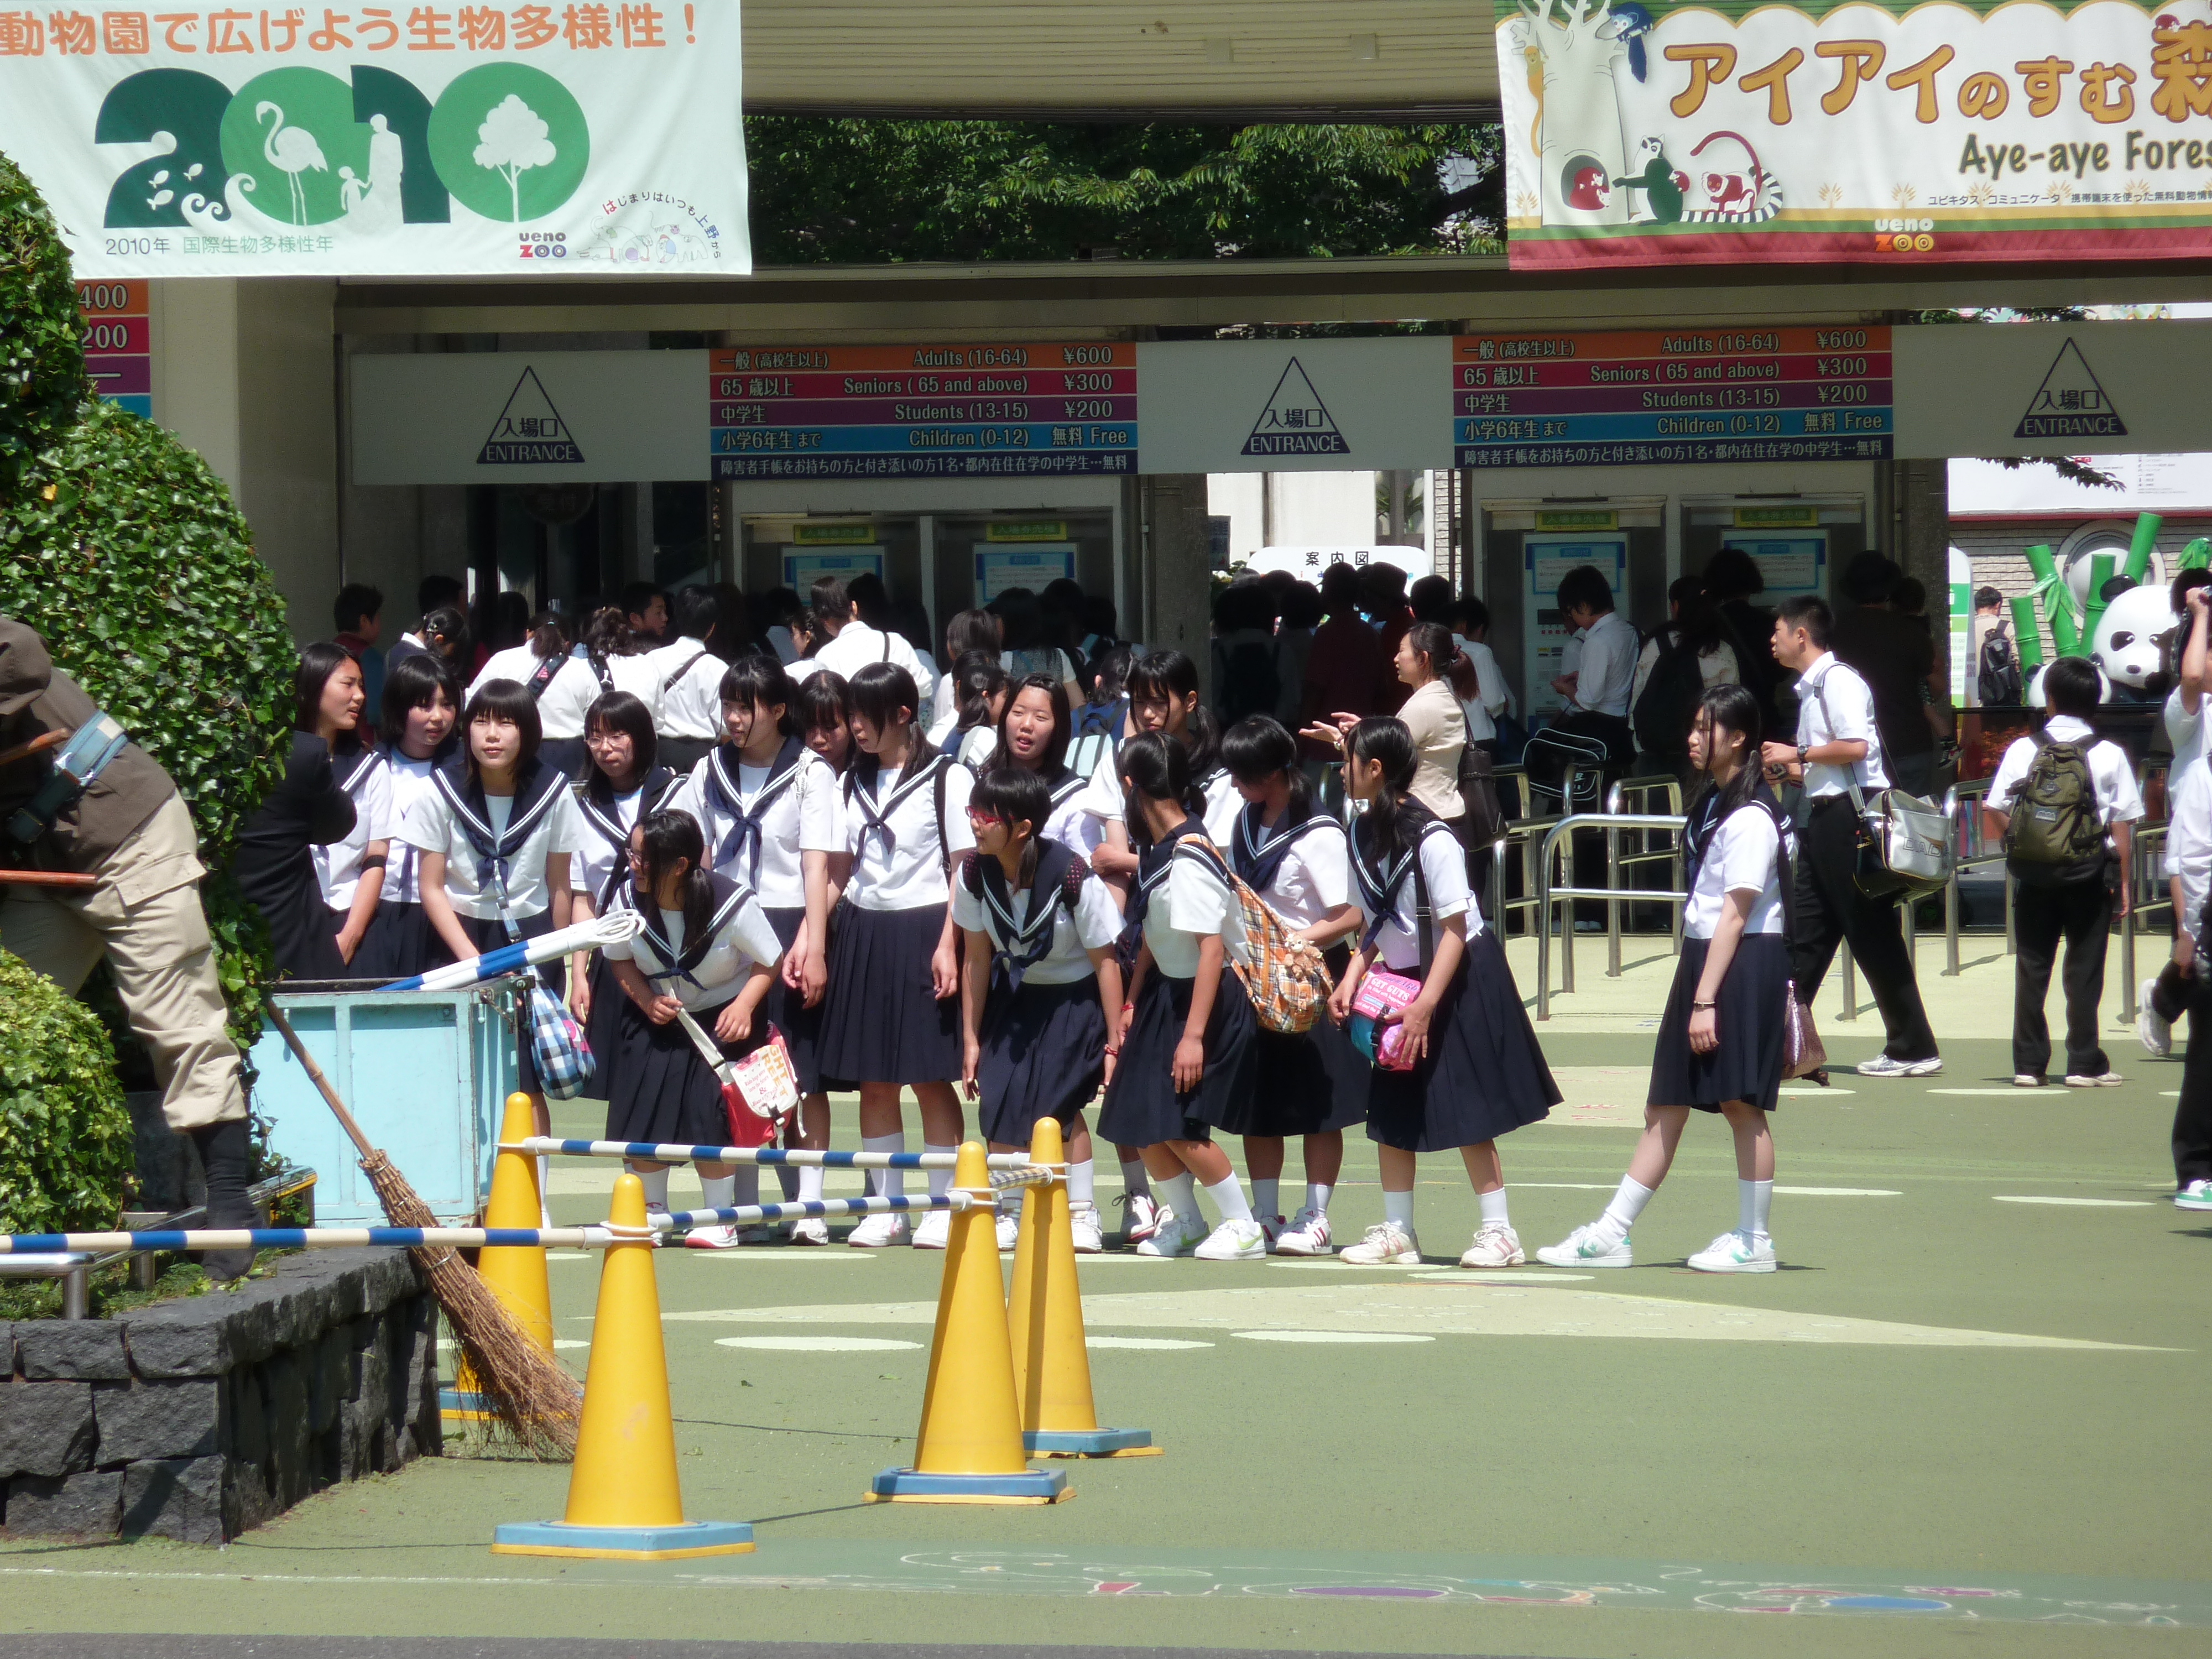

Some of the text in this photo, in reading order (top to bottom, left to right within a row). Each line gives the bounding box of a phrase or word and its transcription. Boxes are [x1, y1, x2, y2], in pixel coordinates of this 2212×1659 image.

[1959, 132, 2110, 180] Aye-aye
[602, 191, 721, 258] はじまりはいつも上野から
[106, 236, 333, 255] 2010年 国際生物多様性年
[78, 284, 128, 309] 400
[1463, 330, 1867, 359] 一般 (高校生以上) Adults (16-64) ¥600
[721, 346, 1112, 370] 一般 (高校生以上) Adults (16-64) ¥600
[1464, 368, 1487, 385] 65
[1493, 366, 1540, 386] 歳以上
[1591, 365, 1650, 382] Seniors
[1694, 362, 1722, 379] and
[1728, 361, 1780, 379] above)
[1818, 357, 1867, 375] ¥300
[721, 379, 743, 397] 65
[749, 378, 794, 397] 歳以上
[844, 377, 901, 394] Seniors
[945, 377, 972, 392] and
[978, 375, 1027, 393] above)
[1064, 373, 1113, 391] ¥300
[1464, 385, 1867, 413] 中学生 Students (13-15) ¥200
[2038, 389, 2100, 410] 入場口
[721, 400, 1113, 424] 中学生 Students (13-15) ¥200
[1265, 409, 1323, 429] 入場口
[1658, 416, 1724, 434] Children
[1730, 415, 1781, 434] (0-12)
[1804, 413, 1836, 432] 無料
[1845, 412, 1882, 429] Free
[500, 418, 558, 437] 入場口
[909, 427, 974, 446] Children
[980, 427, 1029, 447] (0-12)
[1052, 426, 1083, 446] 無料
[1091, 426, 1128, 444] Free
[2023, 417, 2117, 435] ENTRANCE
[486, 444, 575, 461] ENTRANCE
[1250, 435, 1340, 452] ENTRANCE
[1306, 551, 1369, 566] 案内図
[1371, 978, 1388, 989] GET
[1387, 985, 1410, 1001] GUTS
